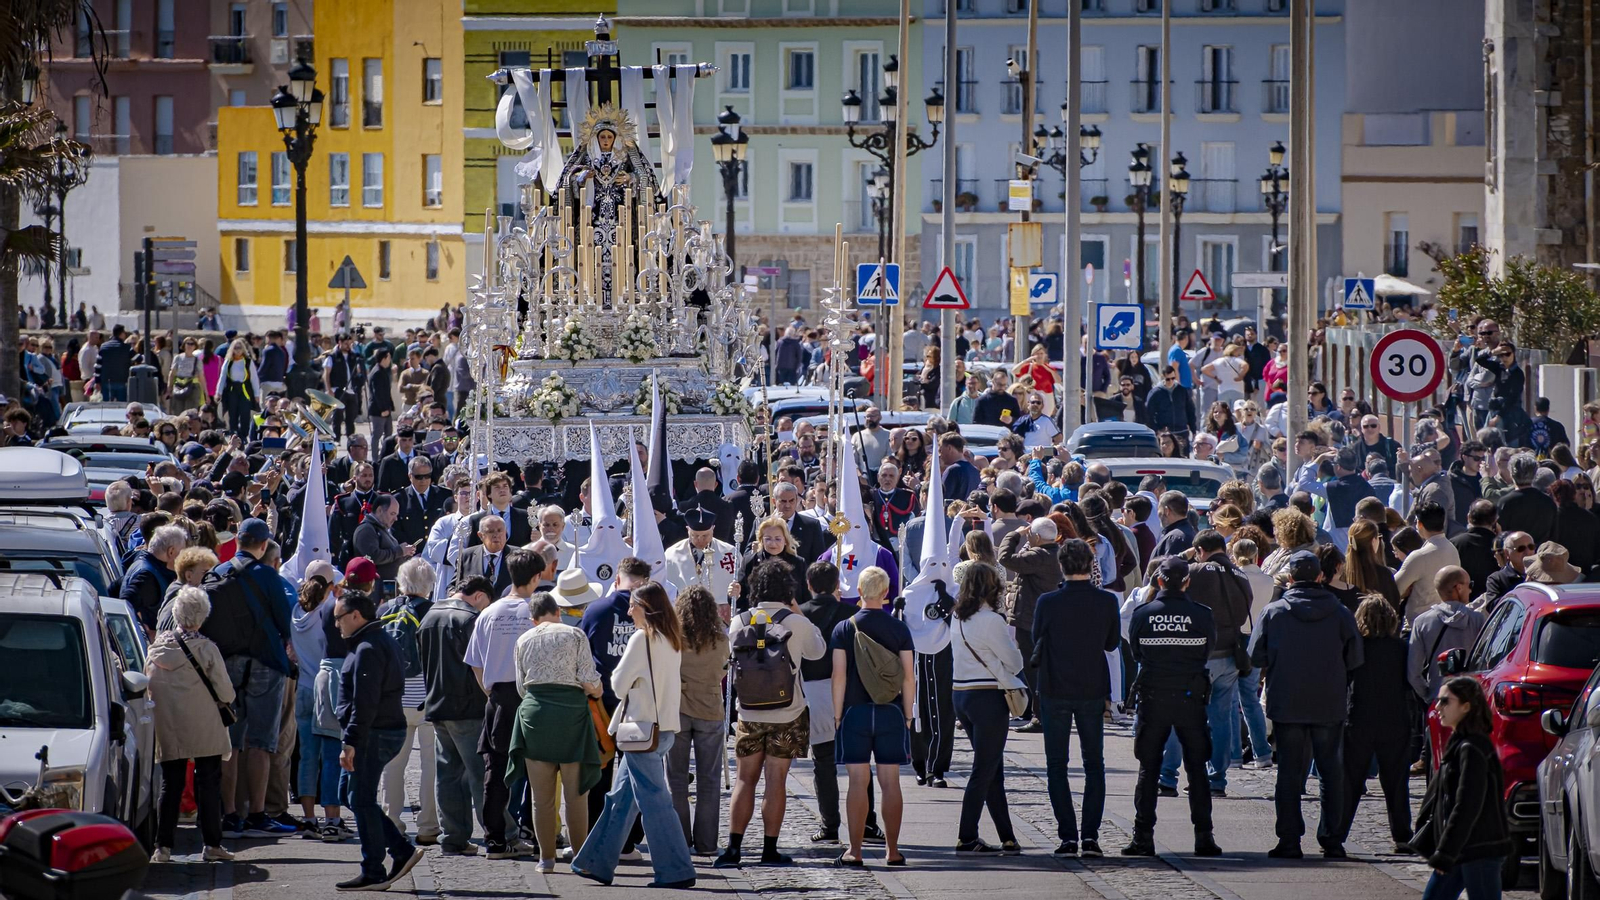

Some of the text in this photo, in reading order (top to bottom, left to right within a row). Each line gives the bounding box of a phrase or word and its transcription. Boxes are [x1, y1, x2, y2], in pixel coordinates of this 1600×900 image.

[1388, 354, 1427, 376] 30
[1149, 615, 1192, 624] POLICIA
[612, 626, 637, 634] FRIE
[1153, 624, 1188, 632] LOCAL
[607, 642, 626, 656] MO
